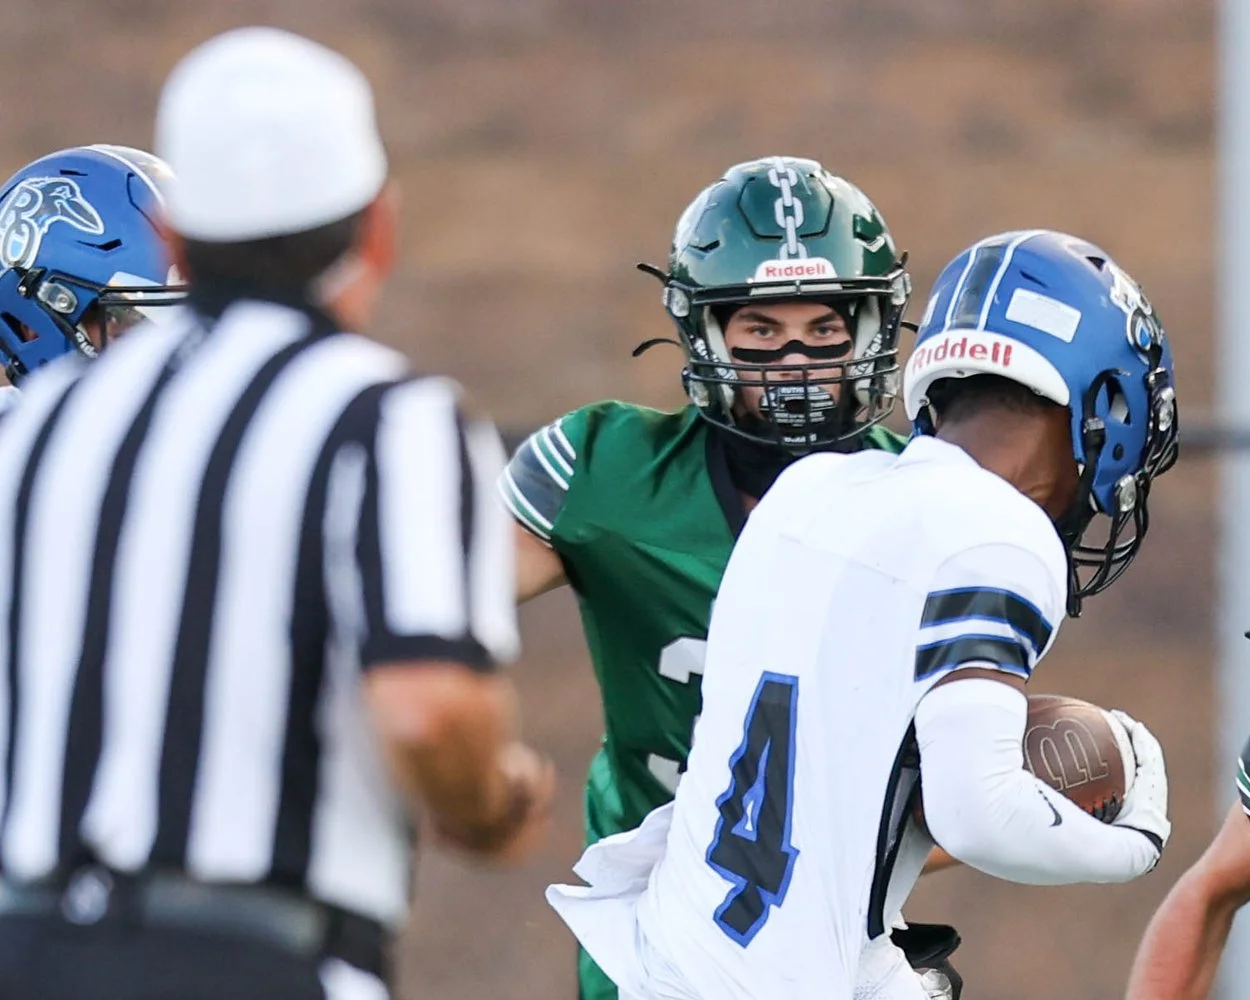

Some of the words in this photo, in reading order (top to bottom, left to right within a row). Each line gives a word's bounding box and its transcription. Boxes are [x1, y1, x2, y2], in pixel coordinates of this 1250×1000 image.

[765, 264, 826, 278] Riddell
[911, 337, 1013, 371] Riddell
[706, 670, 800, 949] 4
